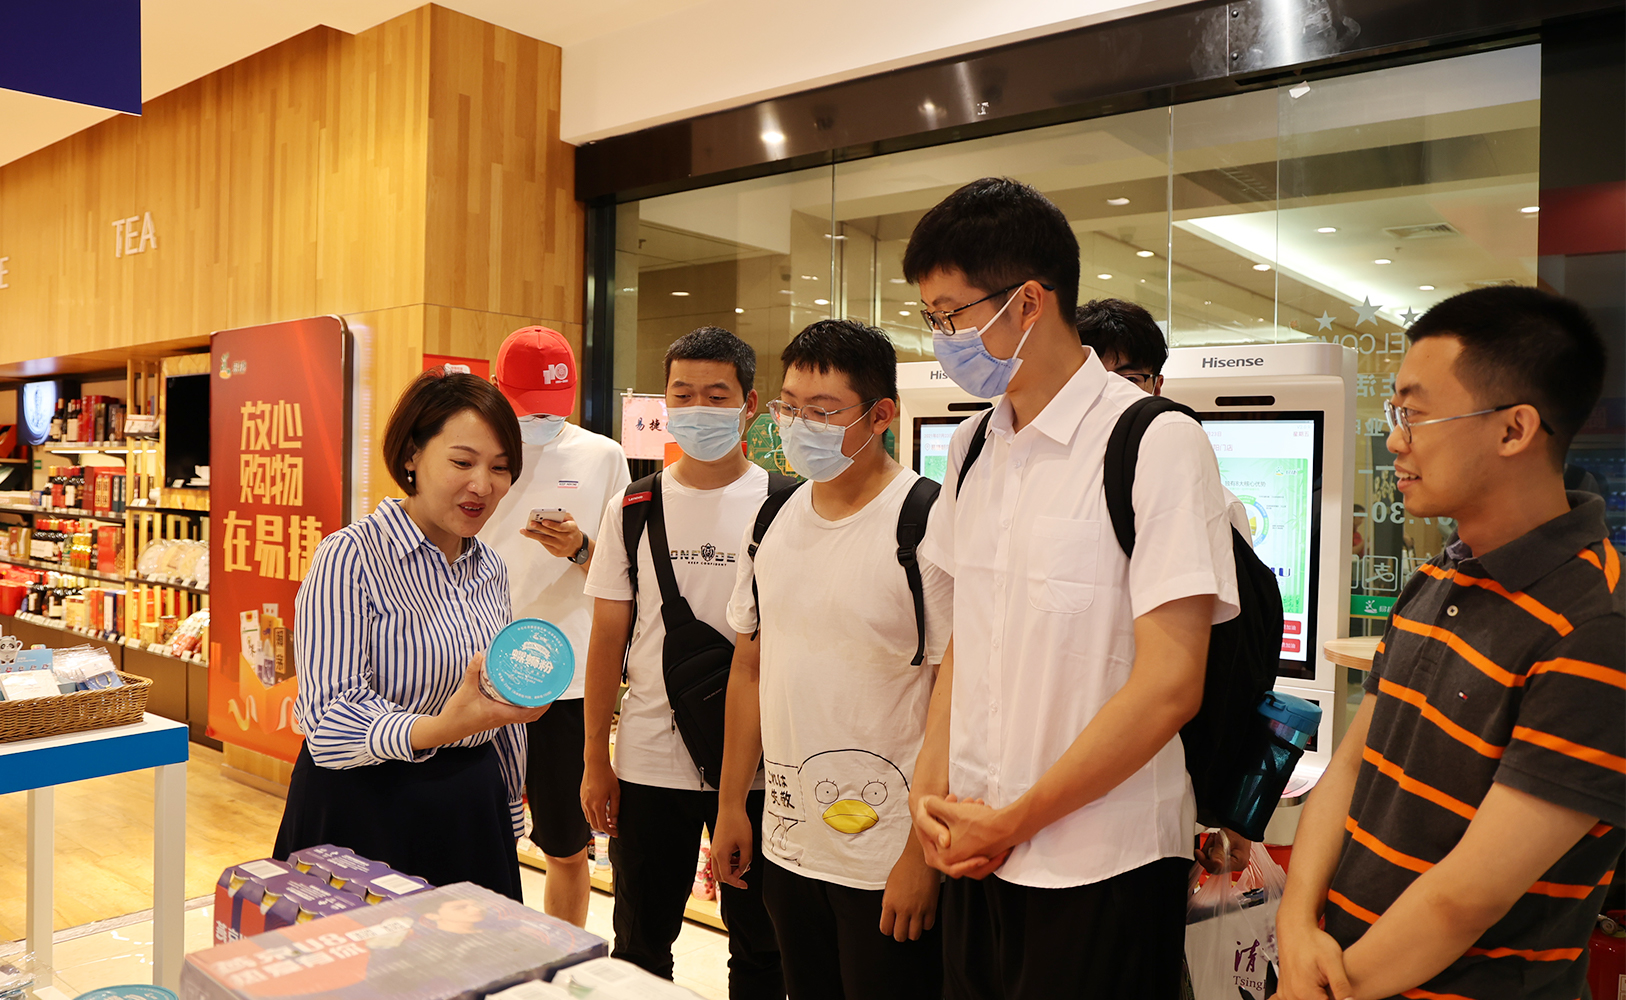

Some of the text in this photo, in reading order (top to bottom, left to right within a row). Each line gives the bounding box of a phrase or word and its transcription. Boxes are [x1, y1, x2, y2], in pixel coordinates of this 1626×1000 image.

[112, 212, 157, 257] TEA
[1201, 355, 1264, 369] Hisense
[240, 400, 303, 450] 放心
[240, 454, 303, 506] 购物
[223, 510, 322, 582] 在易捷
